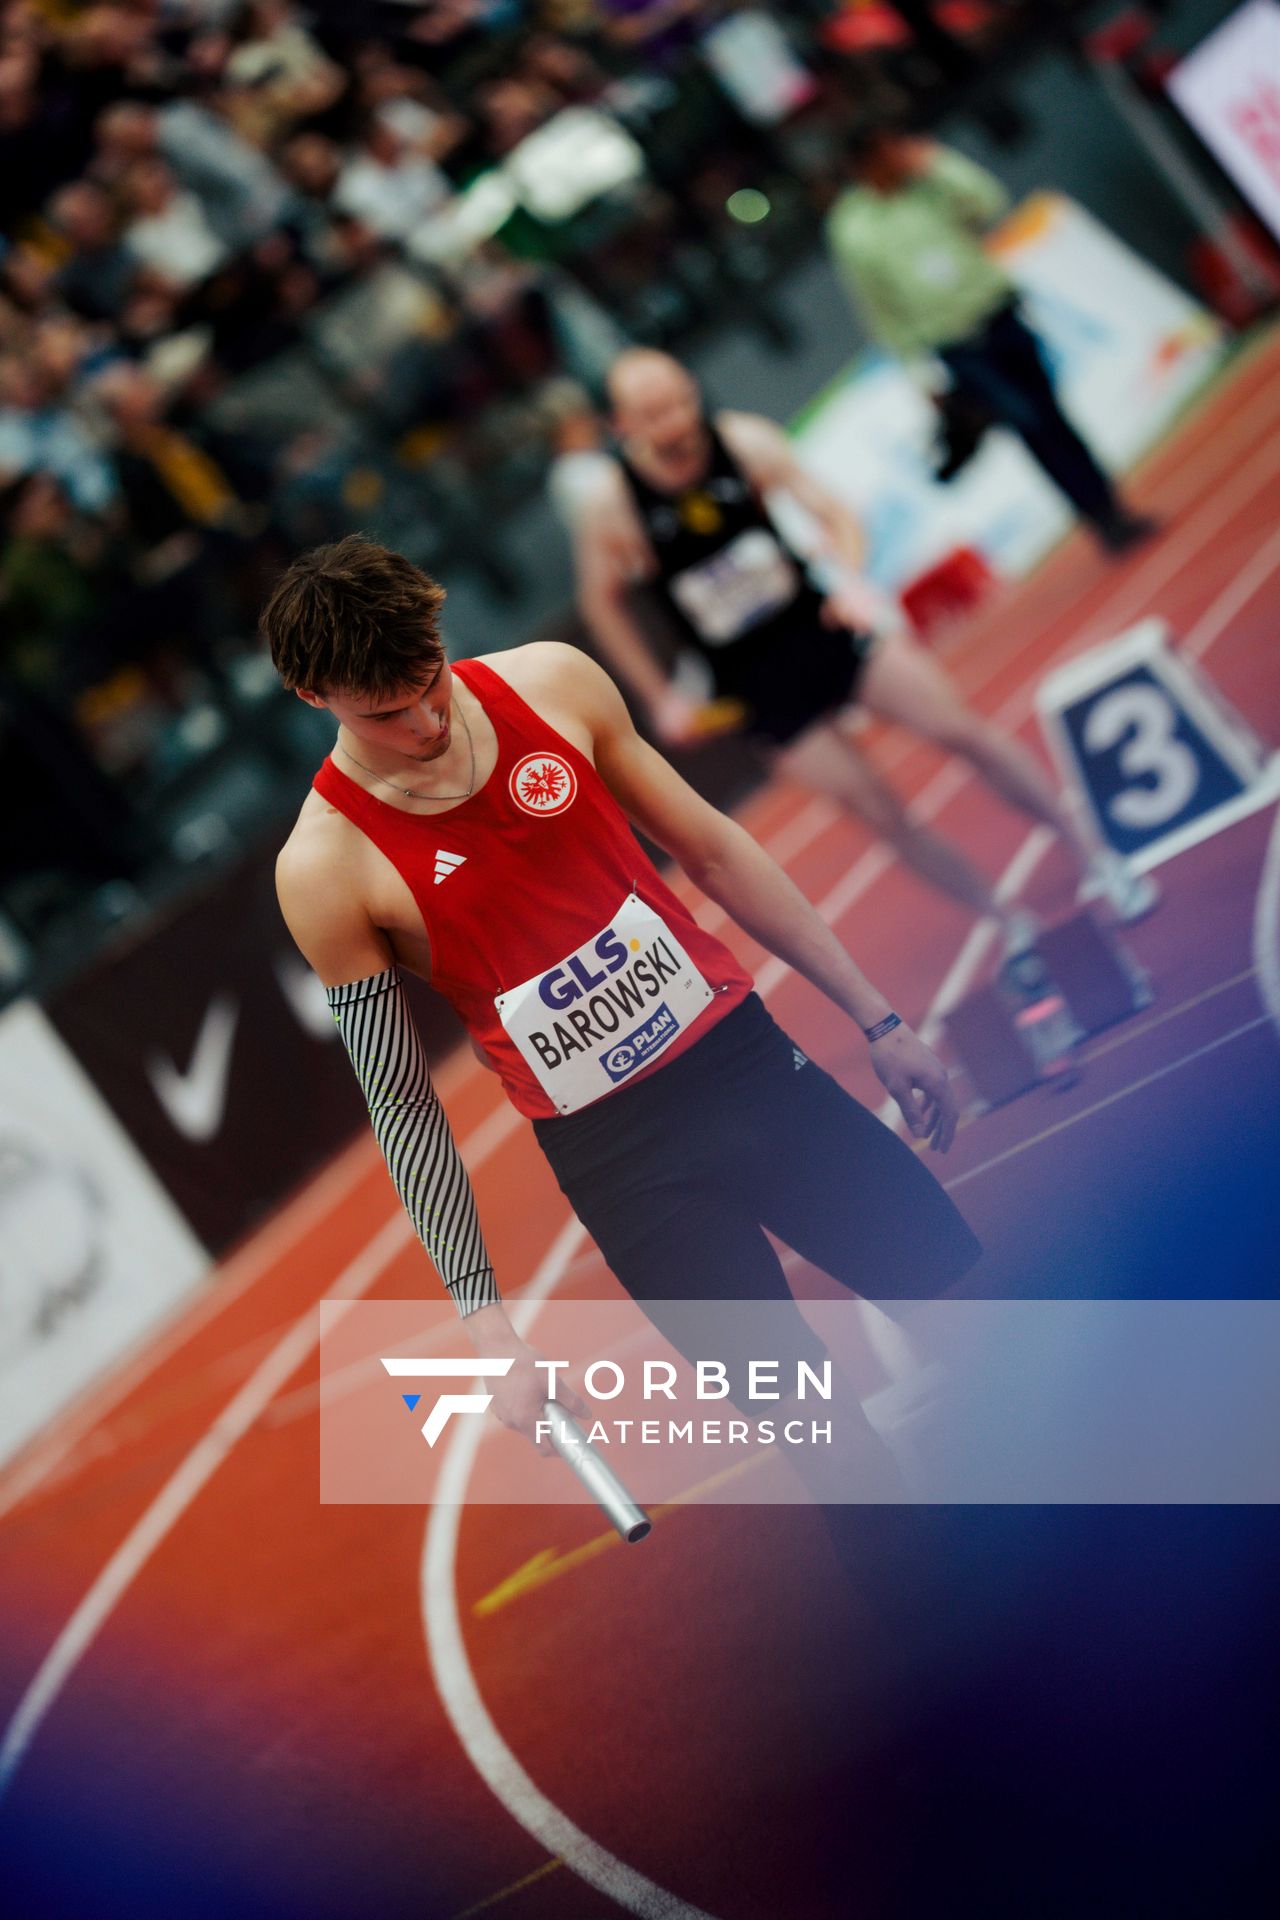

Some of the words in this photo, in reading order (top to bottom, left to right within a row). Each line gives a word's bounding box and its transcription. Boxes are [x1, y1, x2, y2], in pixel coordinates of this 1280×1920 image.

[1083, 683, 1199, 829] 3
[528, 936, 682, 1071] BAROWSKI
[632, 1010, 672, 1051] PLAN
